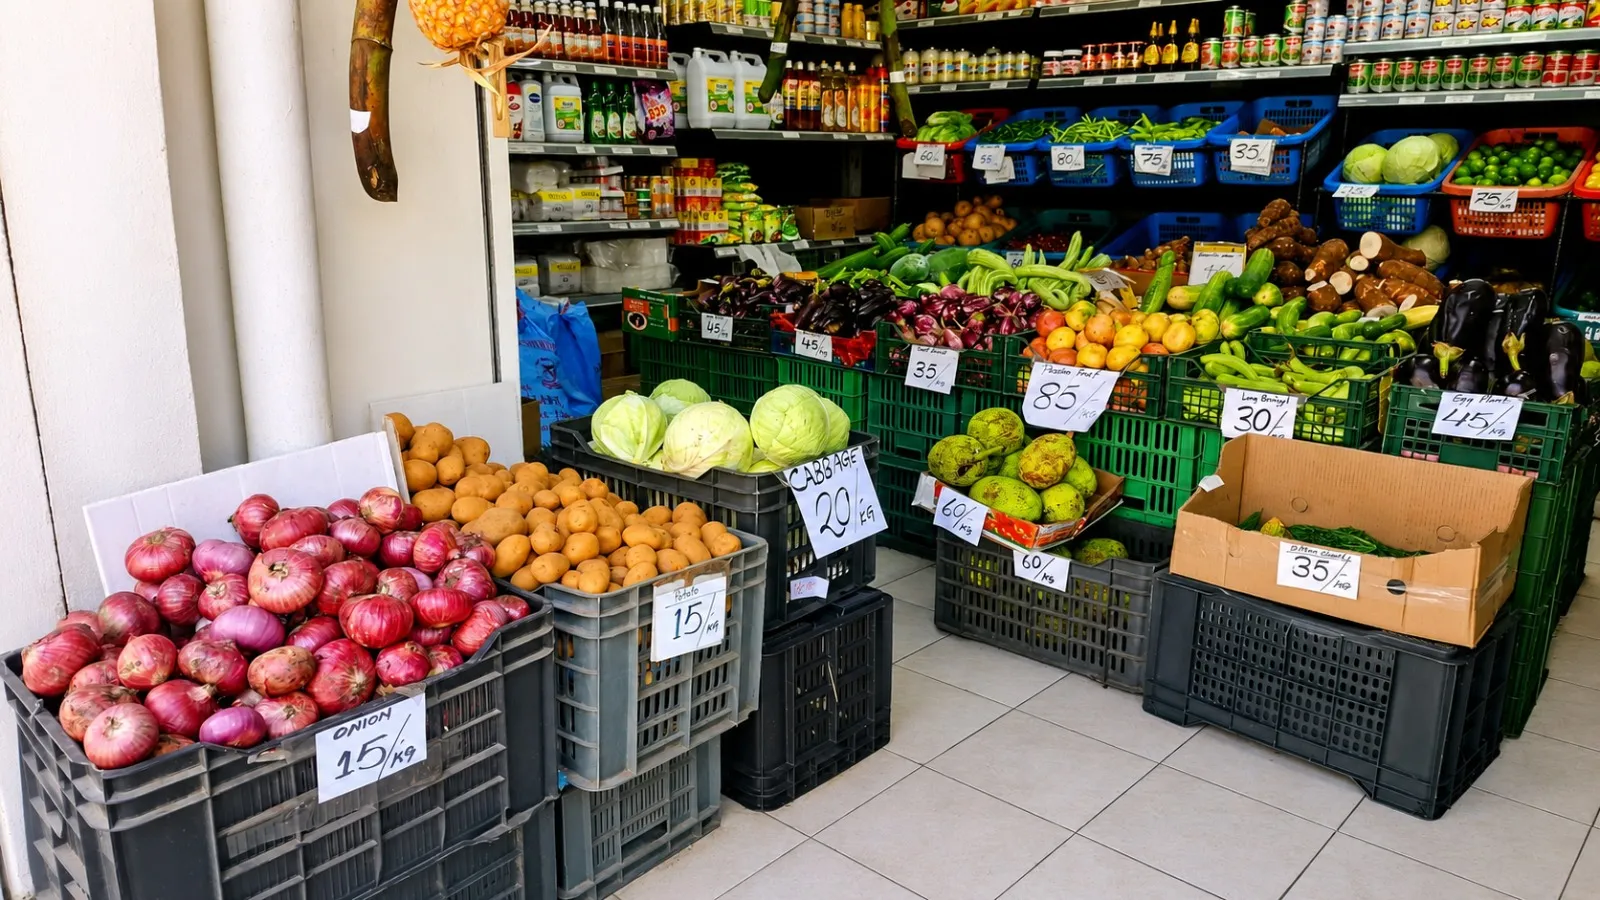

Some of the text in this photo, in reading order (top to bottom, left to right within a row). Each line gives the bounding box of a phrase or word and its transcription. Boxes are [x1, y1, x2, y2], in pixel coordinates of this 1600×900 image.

[789, 448, 859, 492] CABBAGE
[673, 587, 699, 602] Potato
[333, 707, 392, 740] ONION
